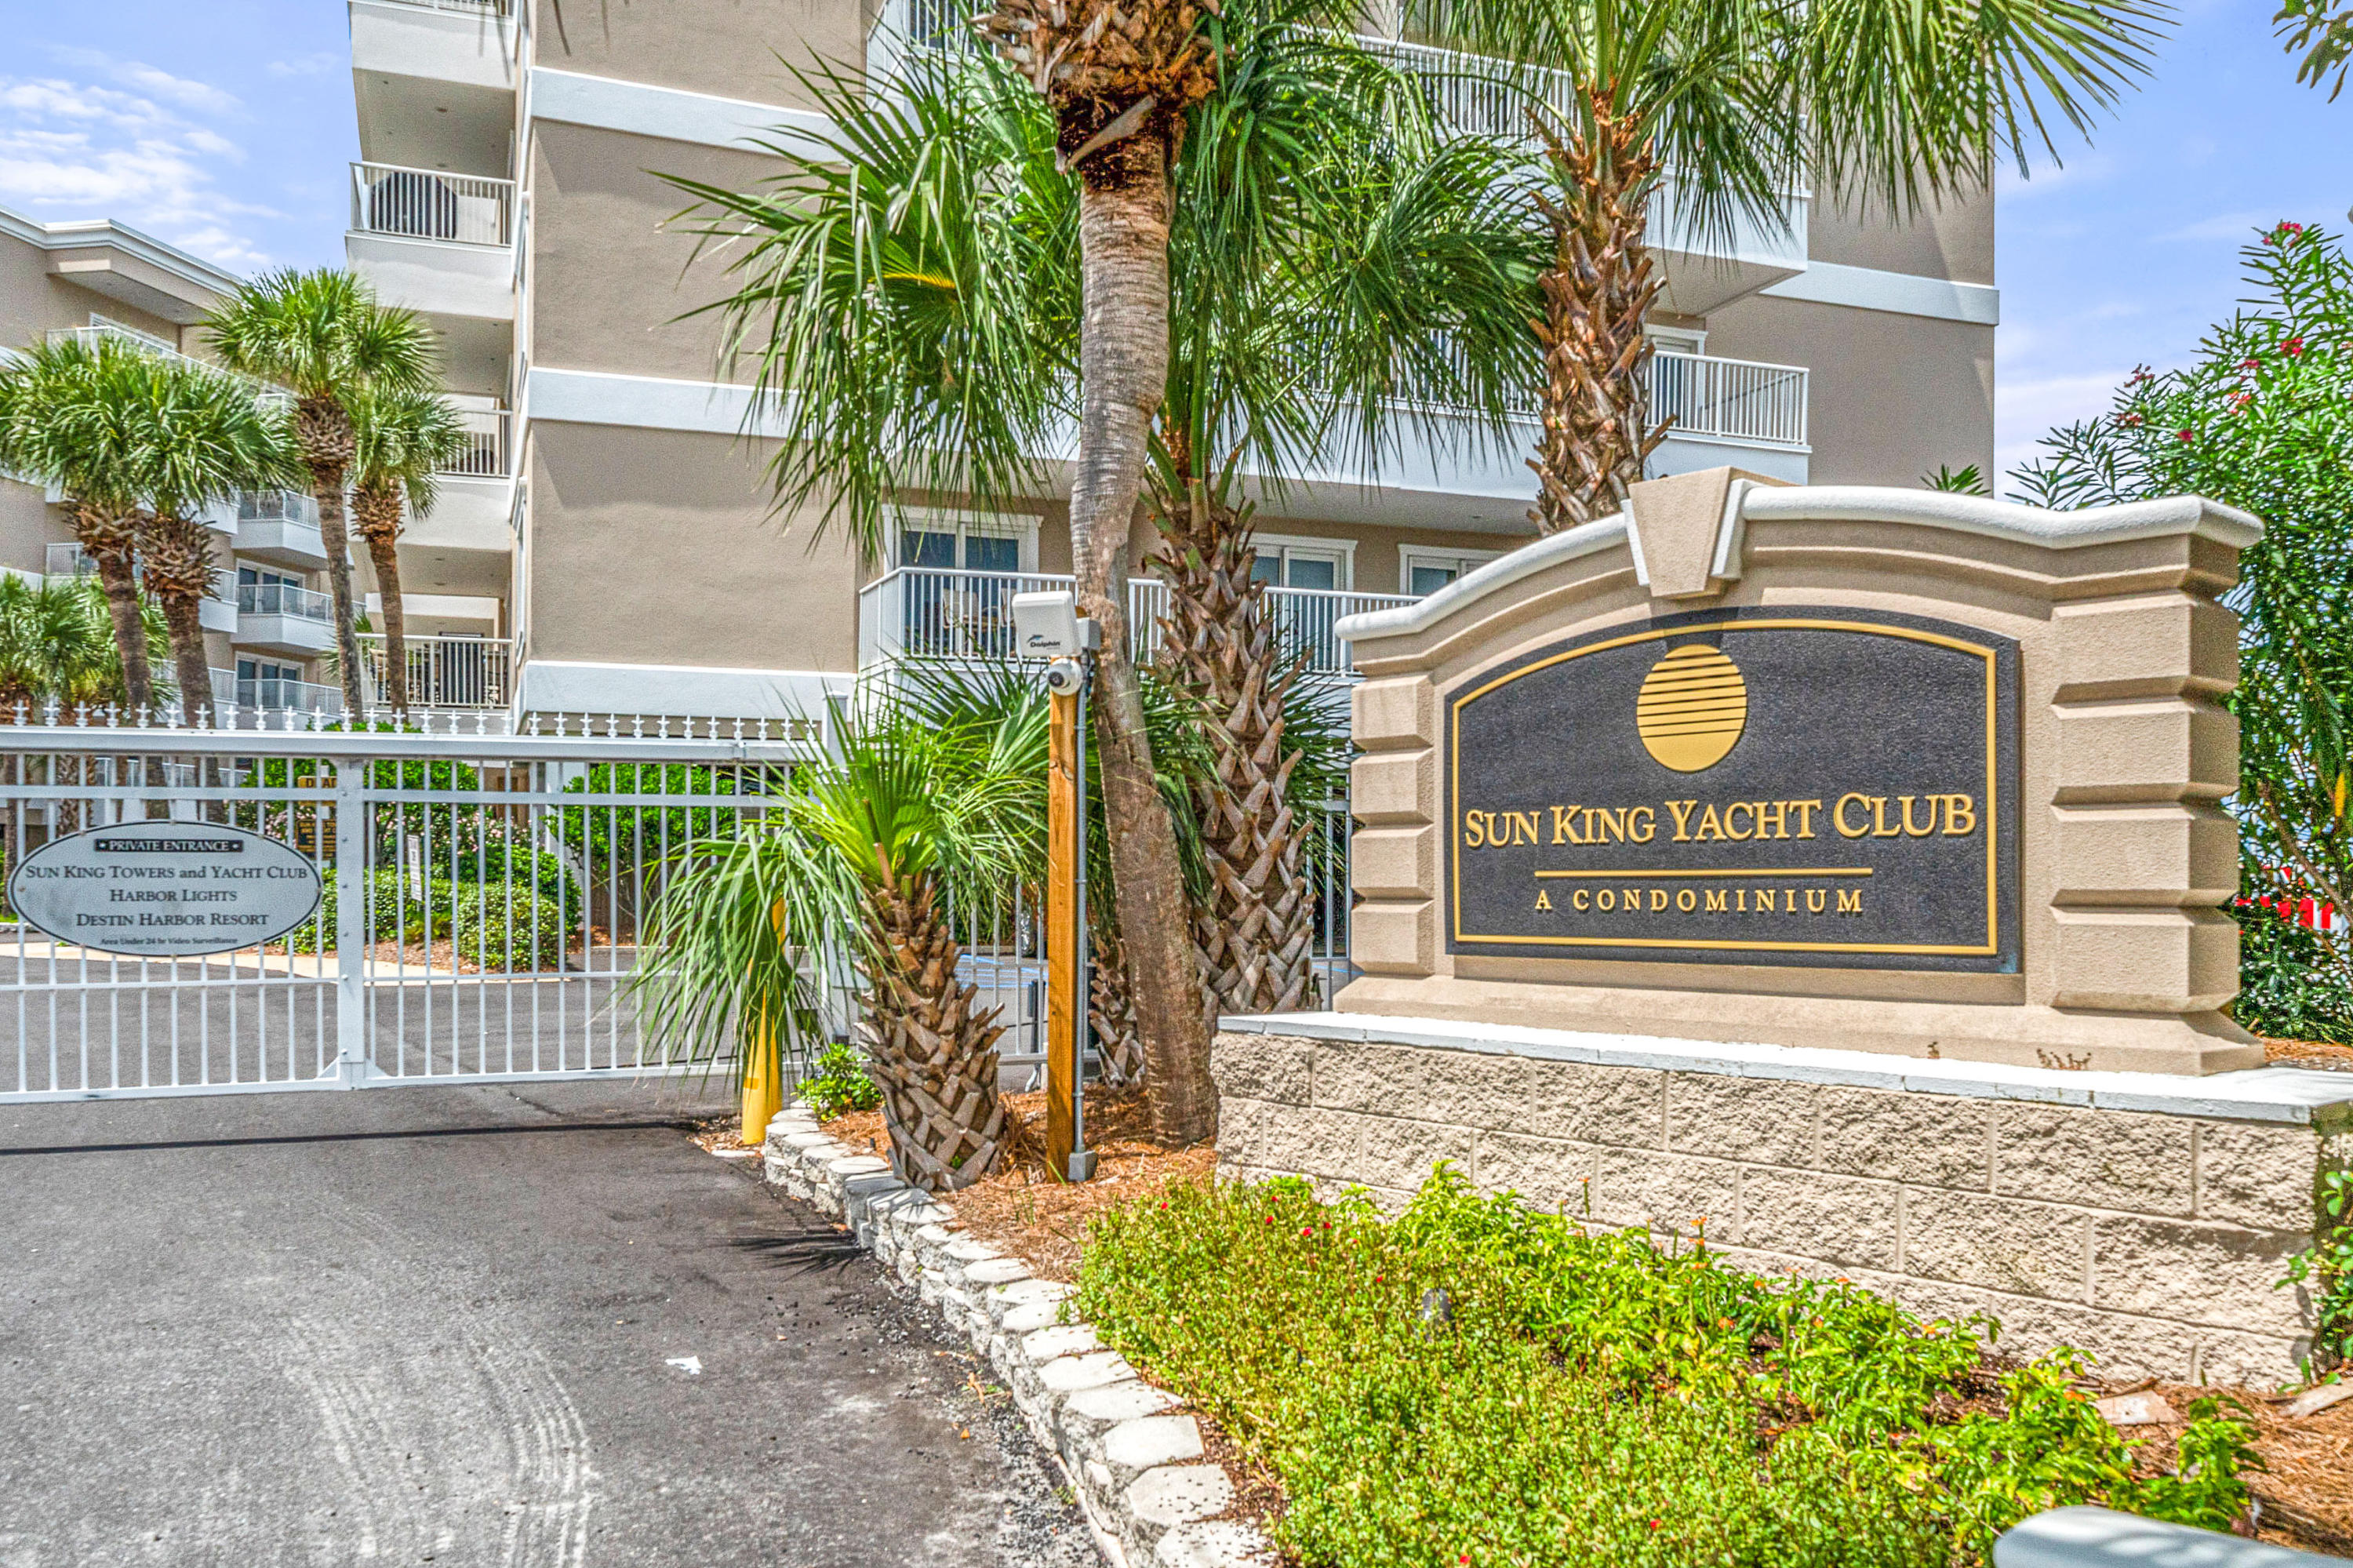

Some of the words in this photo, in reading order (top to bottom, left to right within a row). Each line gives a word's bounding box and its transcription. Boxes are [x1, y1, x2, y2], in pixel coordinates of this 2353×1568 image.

[1465, 809, 1541, 847] SUN
[1549, 805, 1657, 845] KING
[1664, 799, 1823, 842] YACHT
[1833, 791, 1977, 838] CLUB
[109, 840, 162, 851] PRIVATE
[162, 841, 229, 851] ENTRANCE
[25, 865, 60, 879] SUN
[64, 865, 106, 879] KING
[108, 865, 175, 879] TOWERS
[179, 866, 206, 879] and
[209, 866, 264, 879] YACHT
[267, 866, 308, 879] CLUB
[109, 889, 177, 902] HARBOR
[181, 889, 238, 902] LIGHTS
[1534, 889, 1552, 911] A
[1572, 888, 1863, 913] CONDOMINIUM
[76, 913, 134, 926] DESTIN
[139, 913, 205, 926] HARBOR
[210, 912, 269, 926] RESORT
[192, 936, 238, 944] Surveillance
